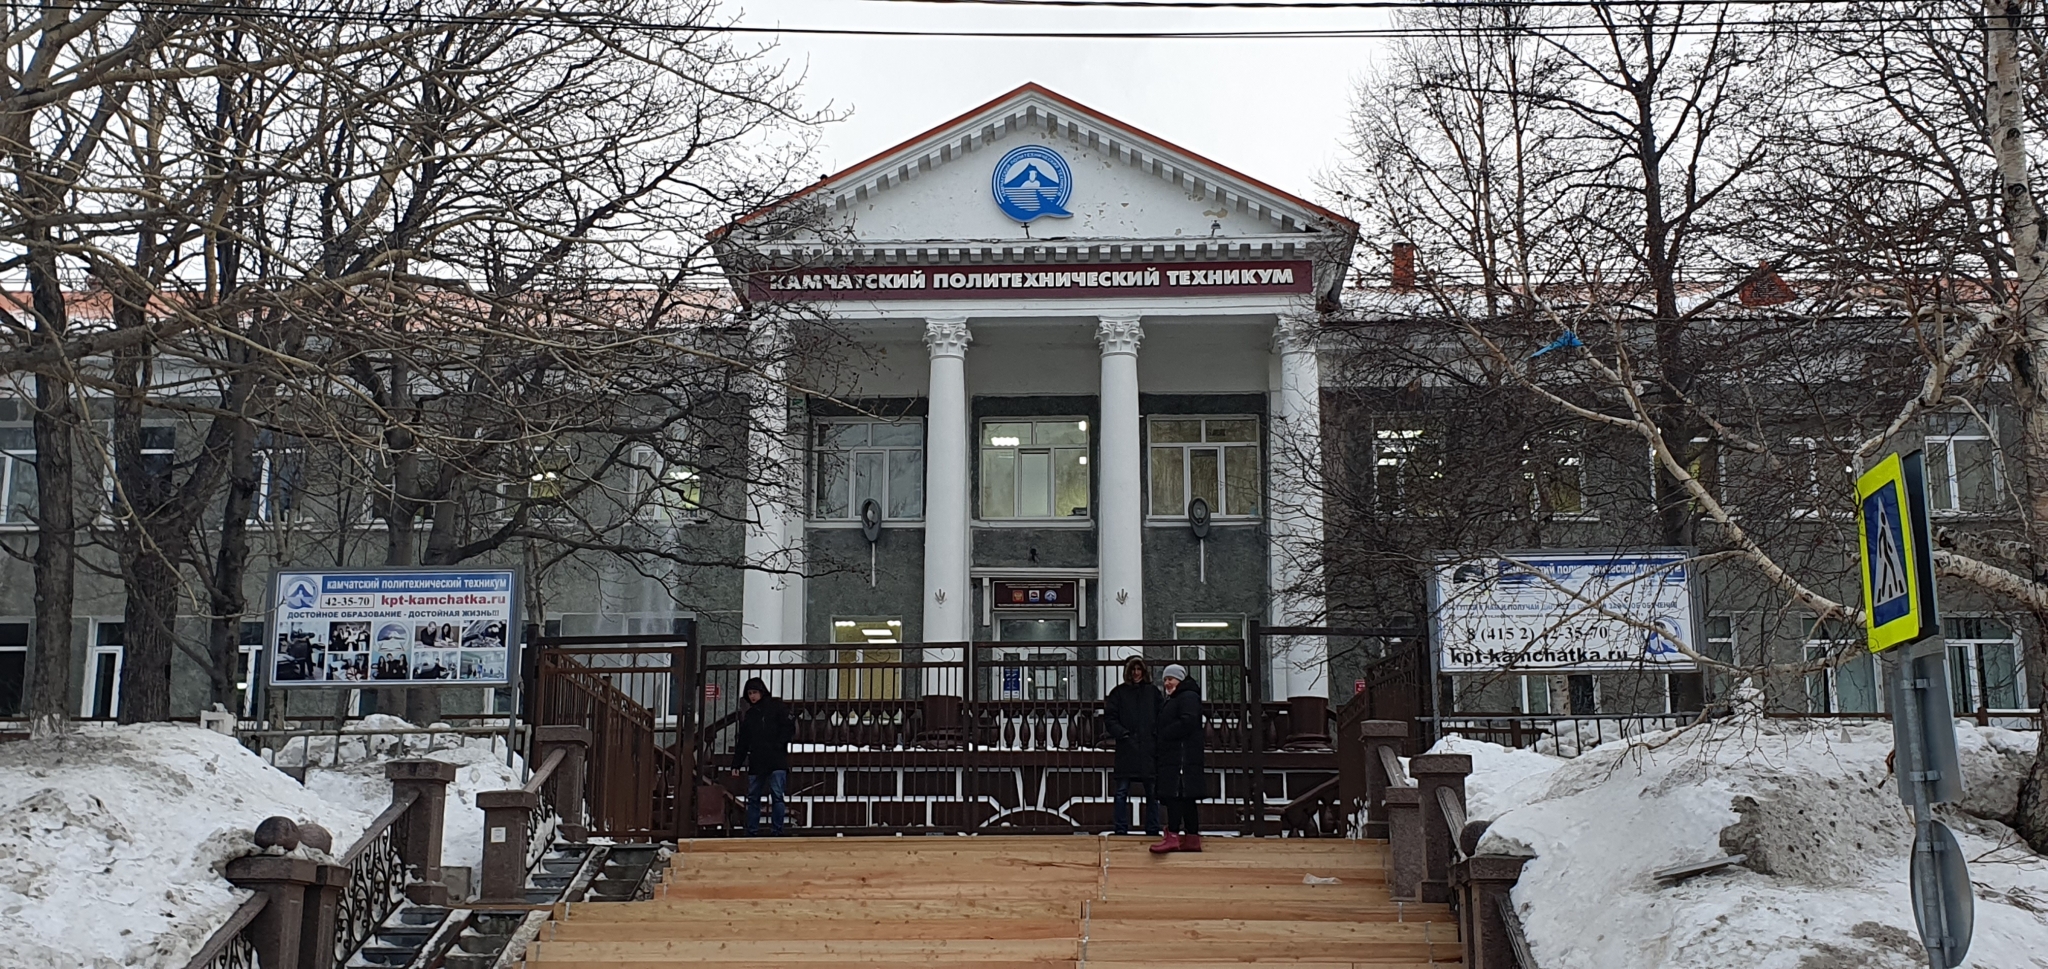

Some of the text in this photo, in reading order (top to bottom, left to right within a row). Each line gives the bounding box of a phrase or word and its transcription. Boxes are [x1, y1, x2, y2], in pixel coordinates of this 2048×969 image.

[769, 267, 1295, 290] КАМЧАТСКИЙ ПОЛИТЕХНИЧЕСКИЙ ТЕХНИКУМ
[326, 576, 507, 590] камчатский политехнический техникум
[325, 596, 370, 606] 42-35-70
[381, 593, 506, 608] kpt-kamchatka.ru
[287, 610, 339, 620] ДОСТОЙНОЕ
[341, 610, 402, 618] ОБРАЗОВАНИЕ
[408, 609, 460, 618] ДОСТОЙНАЯ
[1449, 647, 1628, 667] kpt-kamchatka.ru
